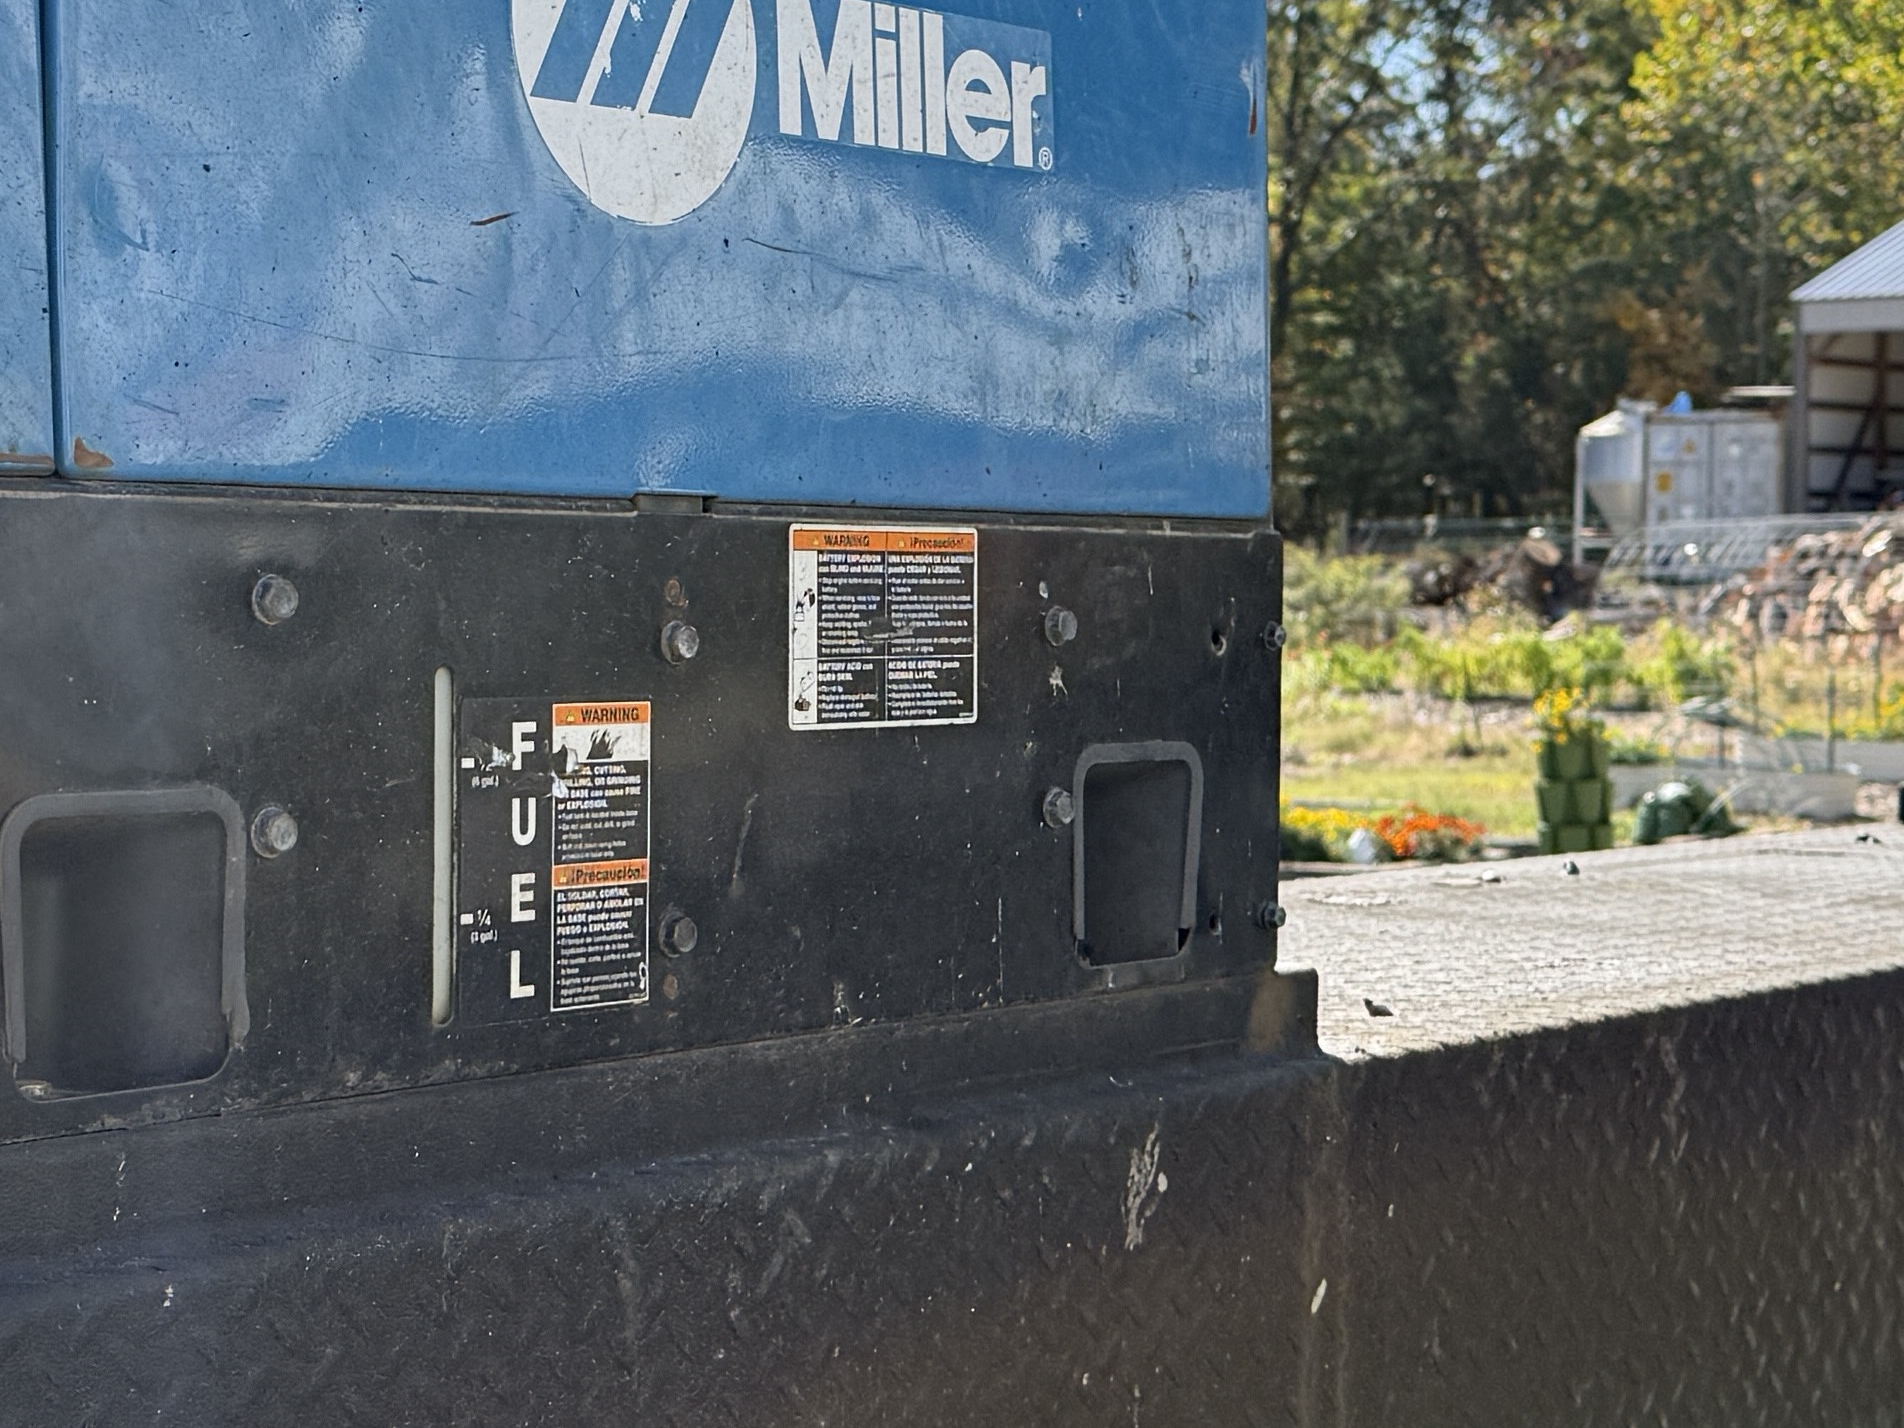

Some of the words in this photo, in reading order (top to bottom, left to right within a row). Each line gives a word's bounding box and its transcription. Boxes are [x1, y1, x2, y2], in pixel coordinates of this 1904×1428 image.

[824, 534, 870, 548] WARNING
[580, 707, 640, 723] WARNING
[509, 721, 537, 999] FUEL
[571, 864, 645, 883] ¡Precaución!
